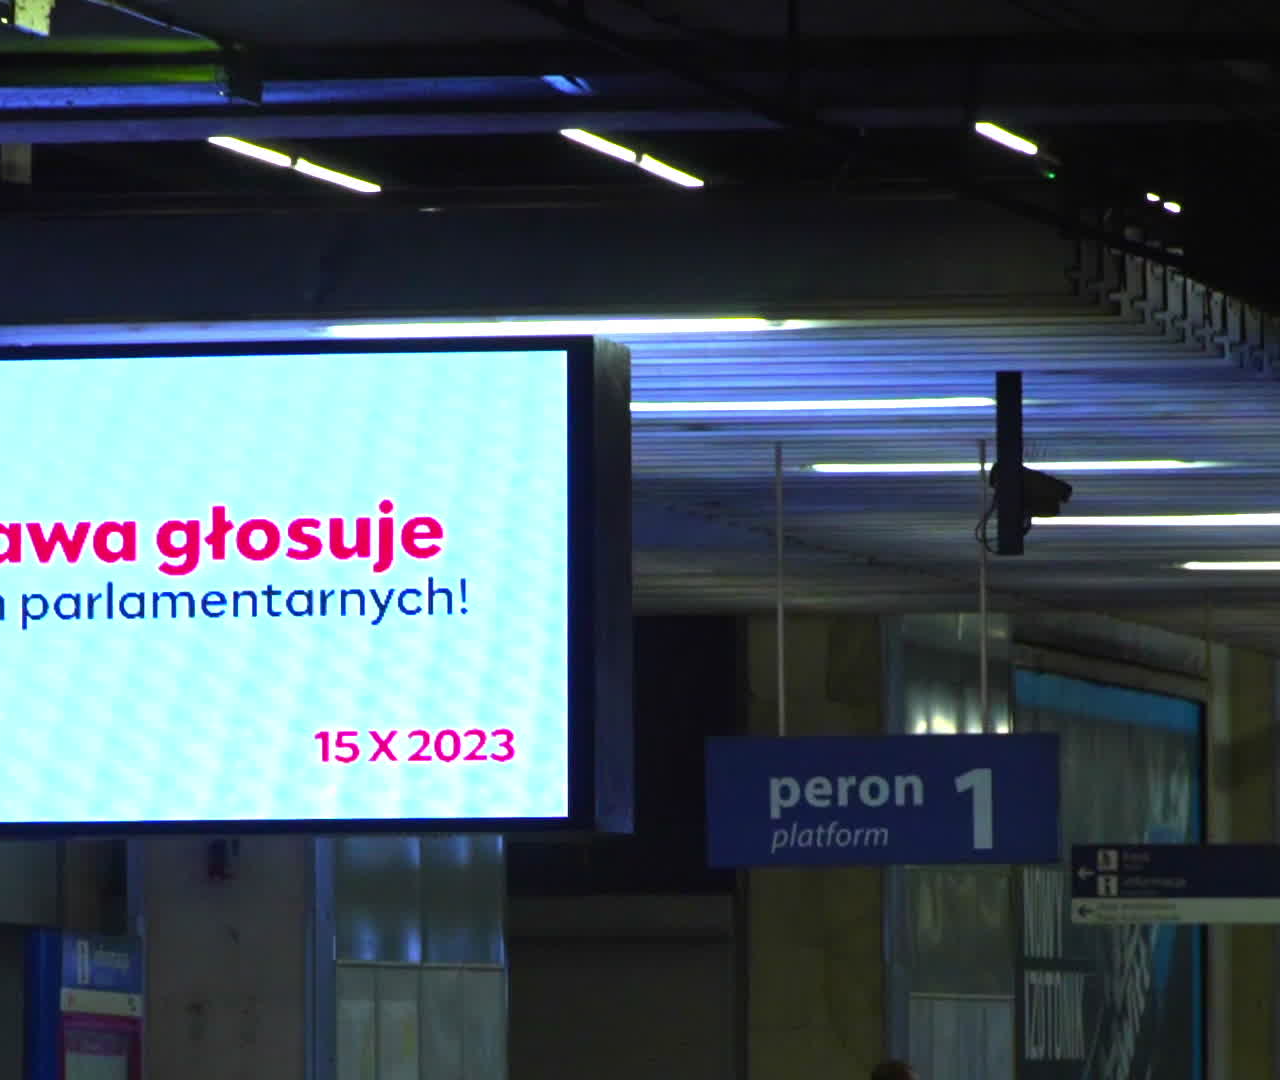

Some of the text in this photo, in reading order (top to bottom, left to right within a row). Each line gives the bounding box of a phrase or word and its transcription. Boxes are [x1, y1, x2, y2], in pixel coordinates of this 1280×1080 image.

[156, 499, 443, 576] głosuje
[22, 576, 468, 630] parlamentarnych!
[314, 728, 516, 764] 15 X 2023
[769, 767, 993, 849] peron 1
[770, 821, 889, 855] platform
